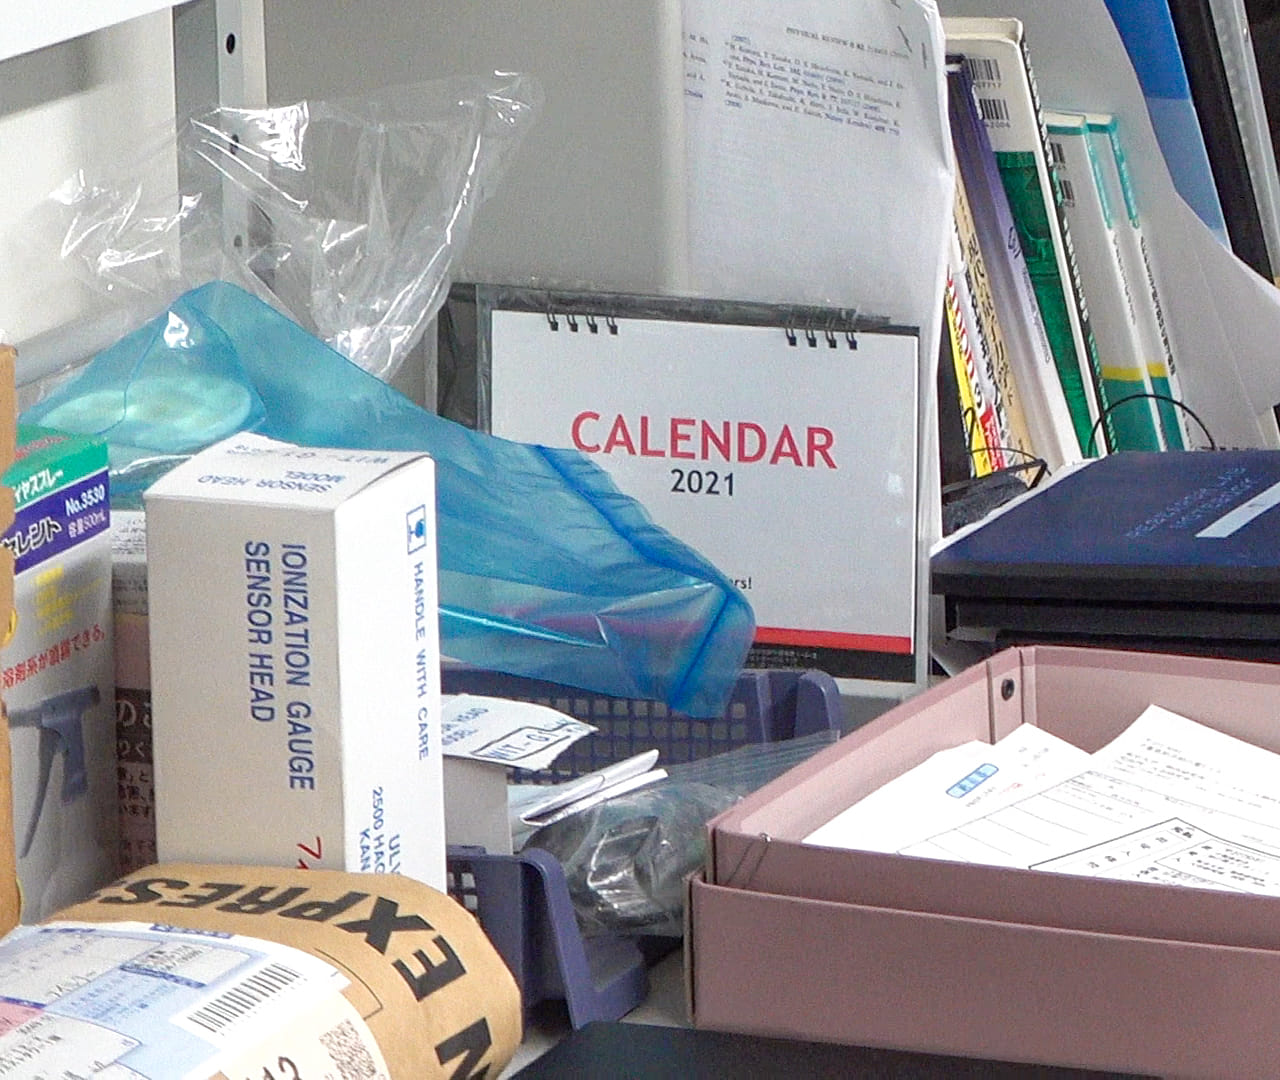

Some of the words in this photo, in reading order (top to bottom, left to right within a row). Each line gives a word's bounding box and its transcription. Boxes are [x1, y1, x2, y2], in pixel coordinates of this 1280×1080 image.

[571, 411, 837, 469] CALENDAR
[197, 474, 250, 487] HEAD
[255, 478, 332, 494] SENSOR
[670, 468, 735, 497] 2021
[244, 540, 273, 643] SENSOR
[282, 543, 311, 687] IONIZATION
[414, 561, 426, 640] HANDLE
[250, 649, 275, 724] HEAD
[416, 648, 428, 698] WITH
[286, 700, 316, 791] GAUGE
[418, 706, 430, 760] CARE
[372, 786, 385, 830] 2500
